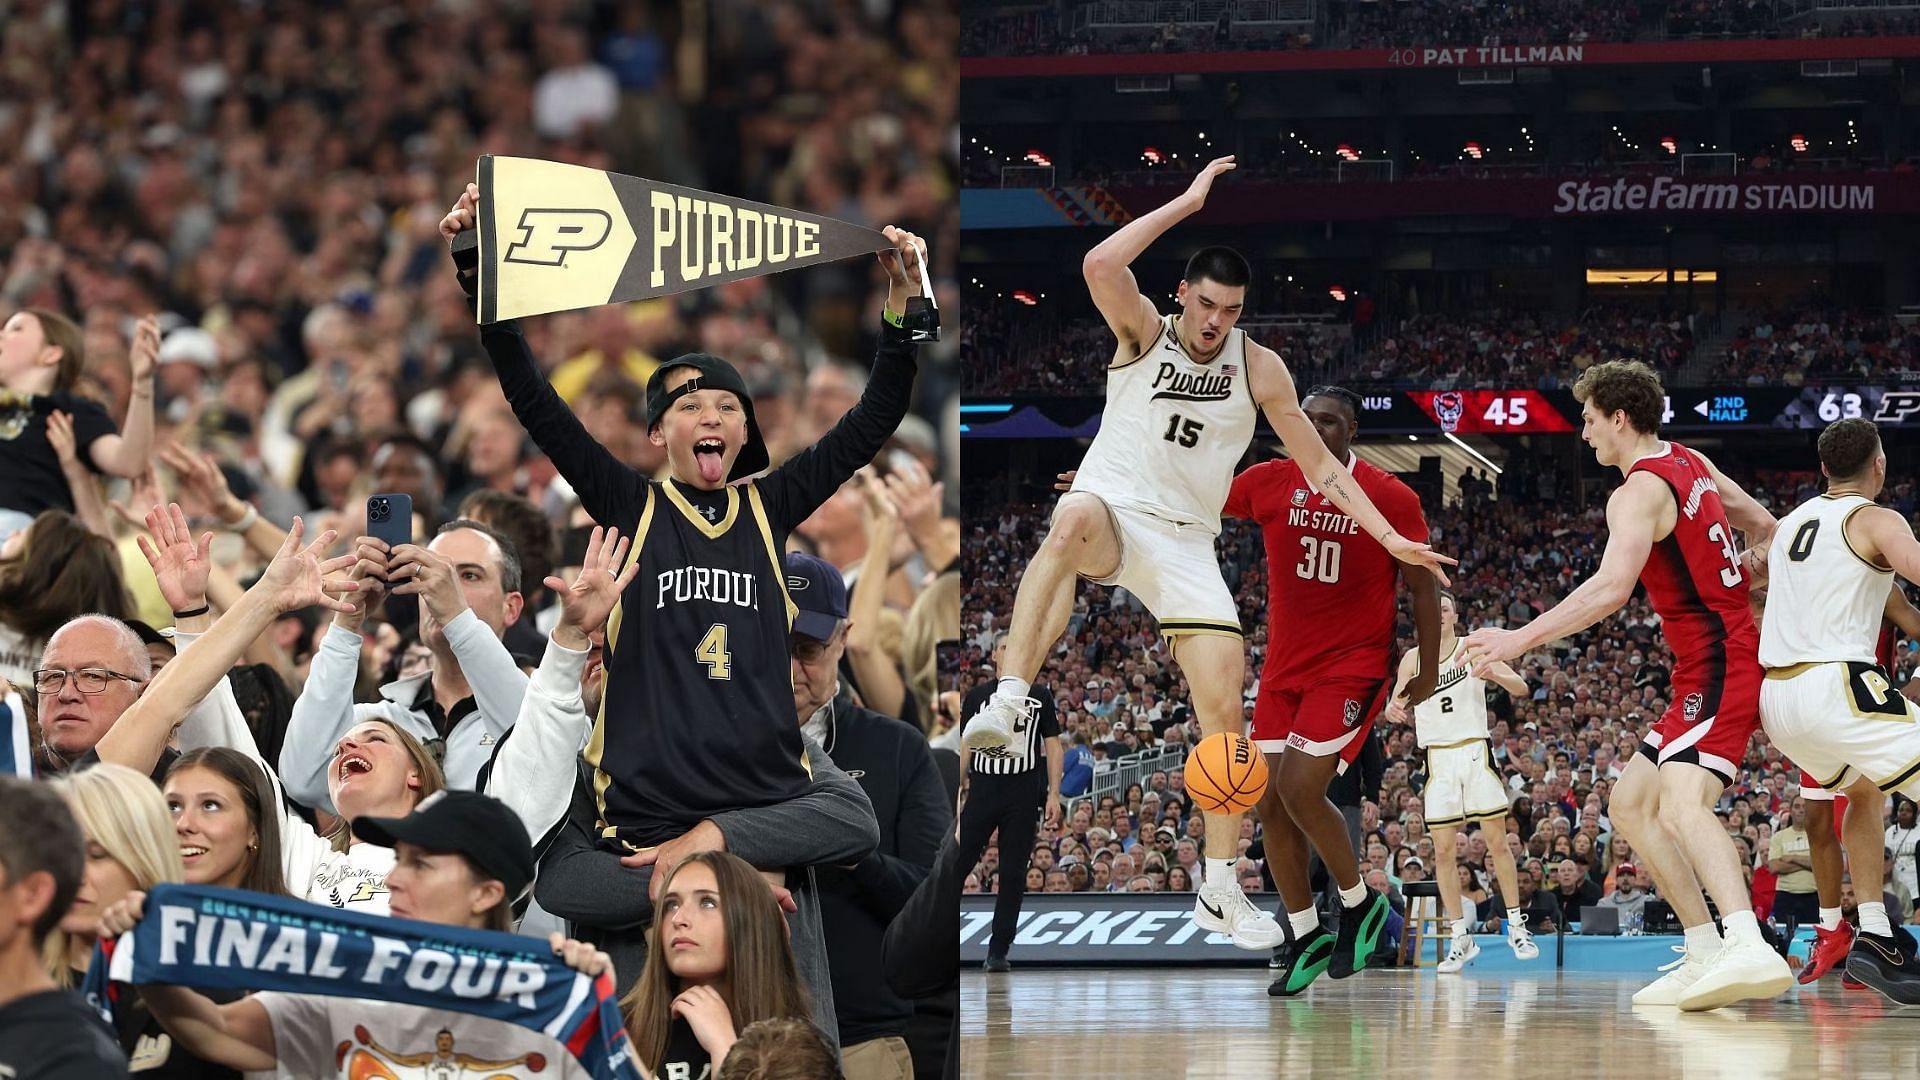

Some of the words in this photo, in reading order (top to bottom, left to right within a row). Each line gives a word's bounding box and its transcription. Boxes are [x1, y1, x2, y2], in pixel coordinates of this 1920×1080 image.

[1388, 49, 1416, 65] 40
[1423, 48, 1468, 65] PAT
[1476, 46, 1584, 64] TILLMAN
[1744, 185, 1875, 209] STADIUM
[651, 190, 820, 288] PURDUE
[1150, 362, 1231, 401] Purdue
[1362, 397, 1392, 410] NUS
[1483, 398, 1528, 425] 45
[1709, 409, 1748, 422] HALF
[1714, 397, 1745, 409] 2ND
[1818, 394, 1862, 422] 63
[1163, 413, 1204, 448] 15
[1288, 508, 1309, 527] NC
[1311, 510, 1359, 535] STATE
[1788, 518, 1820, 563] 0
[1296, 535, 1341, 584] 30
[656, 565, 759, 611] PURDU
[694, 622, 732, 681] 4
[1440, 696, 1454, 714] 2
[1288, 734, 1309, 750] PACK
[960, 911, 1277, 945] TCKET
[159, 905, 347, 980] FINAL
[361, 935, 548, 1010] FOUR
